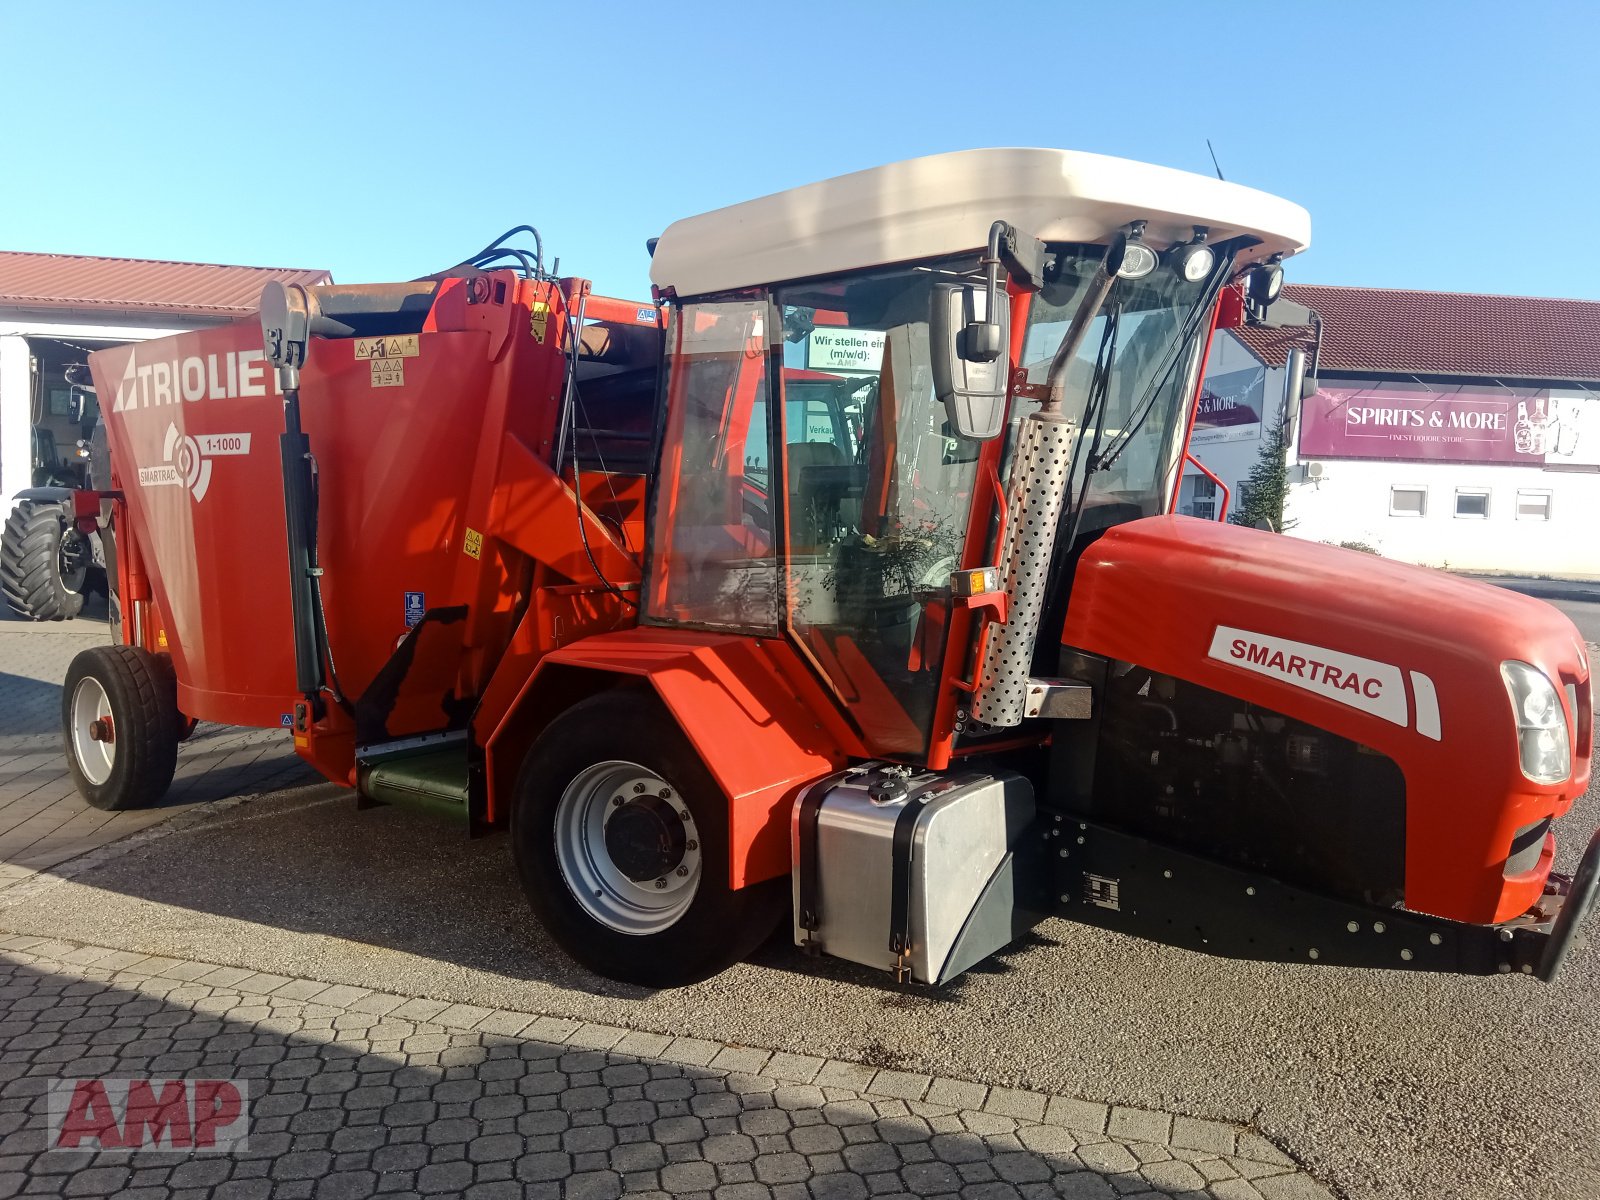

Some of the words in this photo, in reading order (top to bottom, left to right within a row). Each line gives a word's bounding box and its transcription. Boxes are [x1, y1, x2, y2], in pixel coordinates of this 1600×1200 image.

[814, 335, 832, 345] Wir
[835, 337, 868, 348] stellen
[830, 349, 870, 361] (m/w/d):
[837, 358, 858, 367] AMP
[137, 349, 284, 408] TRIOLIE
[1211, 395, 1237, 413] MORE
[1347, 406, 1424, 427] SPIRITS
[1428, 410, 1443, 428] &
[1447, 411, 1505, 430] MORE
[206, 437, 241, 451] 1-1000
[1389, 434, 1413, 442] FINEST
[140, 469, 176, 483] SMARTRAC
[1229, 639, 1384, 699] SMARTRAC
